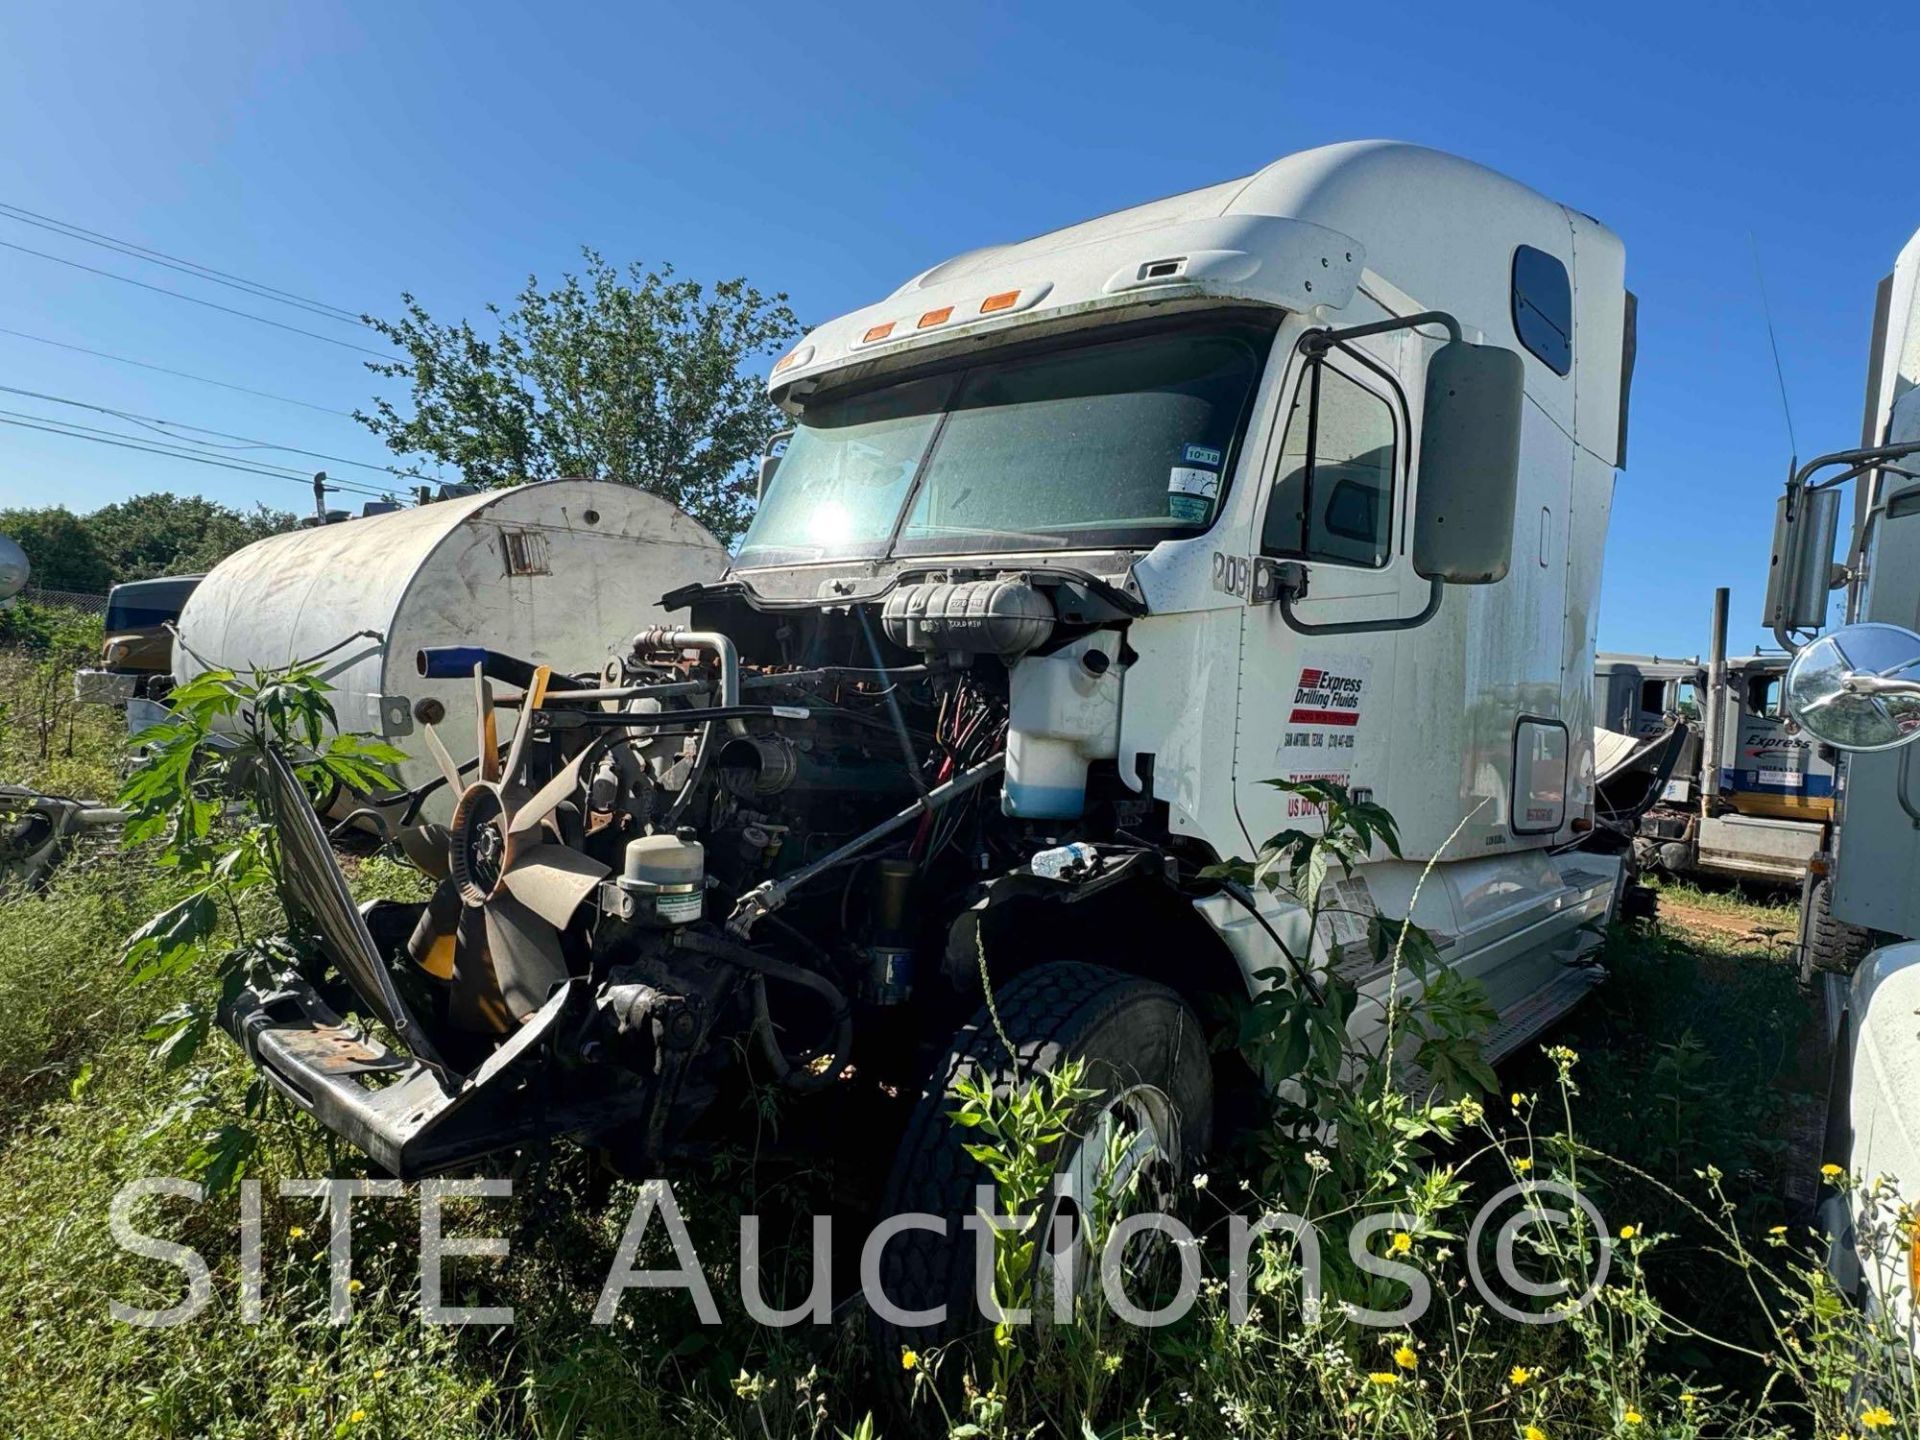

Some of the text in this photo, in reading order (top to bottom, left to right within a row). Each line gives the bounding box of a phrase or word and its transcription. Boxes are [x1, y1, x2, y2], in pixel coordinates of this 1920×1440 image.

[1189, 450, 1218, 462] 10 18
[1319, 671, 1362, 693] Express
[1294, 688, 1359, 709] Drilling Fluids
[1746, 734, 1812, 749] Express
[1288, 798, 1299, 817] US
